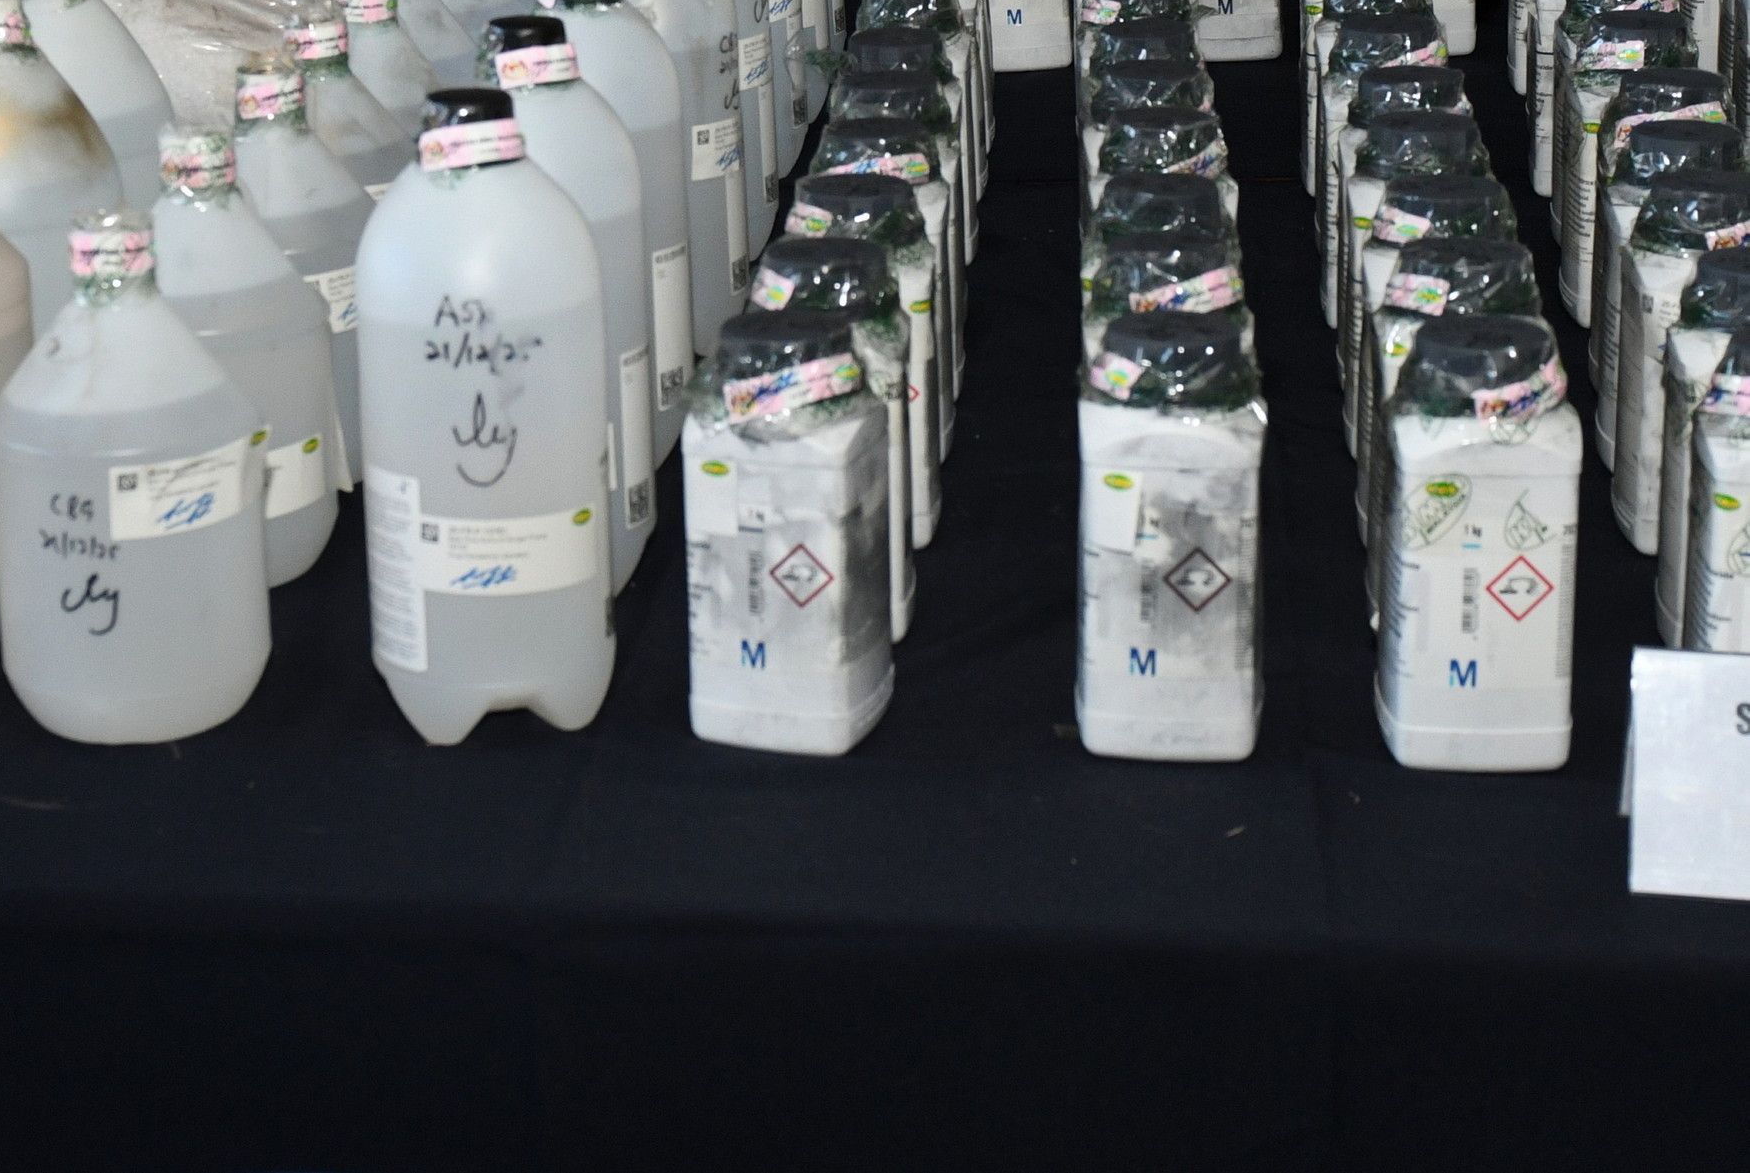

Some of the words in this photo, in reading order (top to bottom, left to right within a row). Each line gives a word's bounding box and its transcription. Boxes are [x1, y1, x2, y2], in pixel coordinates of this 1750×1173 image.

[1007, 9, 1022, 24] M
[1217, 0, 1233, 14] M
[741, 639, 766, 669] M
[1130, 647, 1157, 676] M
[1449, 659, 1477, 688] M
